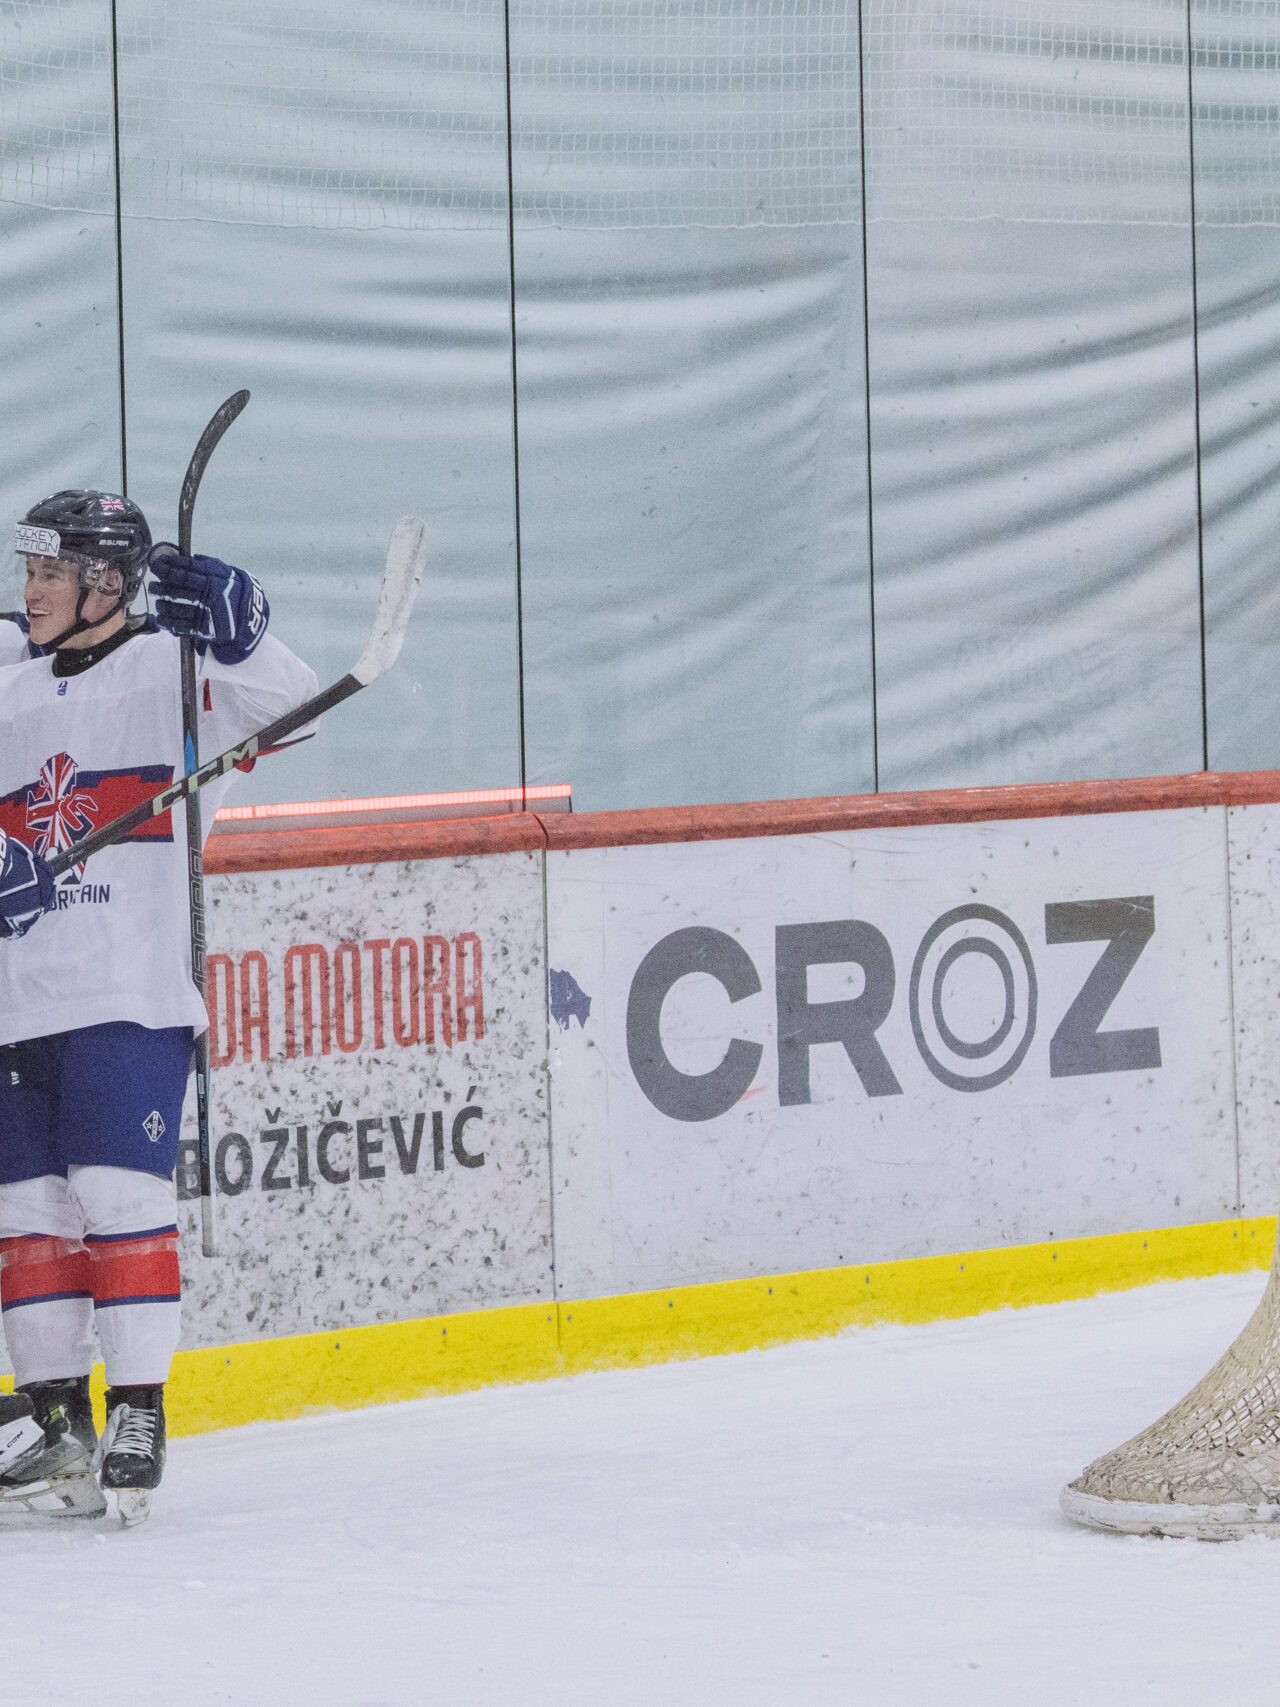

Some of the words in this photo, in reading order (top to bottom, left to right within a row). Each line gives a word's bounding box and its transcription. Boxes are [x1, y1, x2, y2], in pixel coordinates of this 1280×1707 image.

[152, 735, 259, 816] CCM
[51, 884, 110, 911] RITAIN
[284, 932, 485, 1060] MOTORA
[625, 895, 1162, 1123] CROZ
